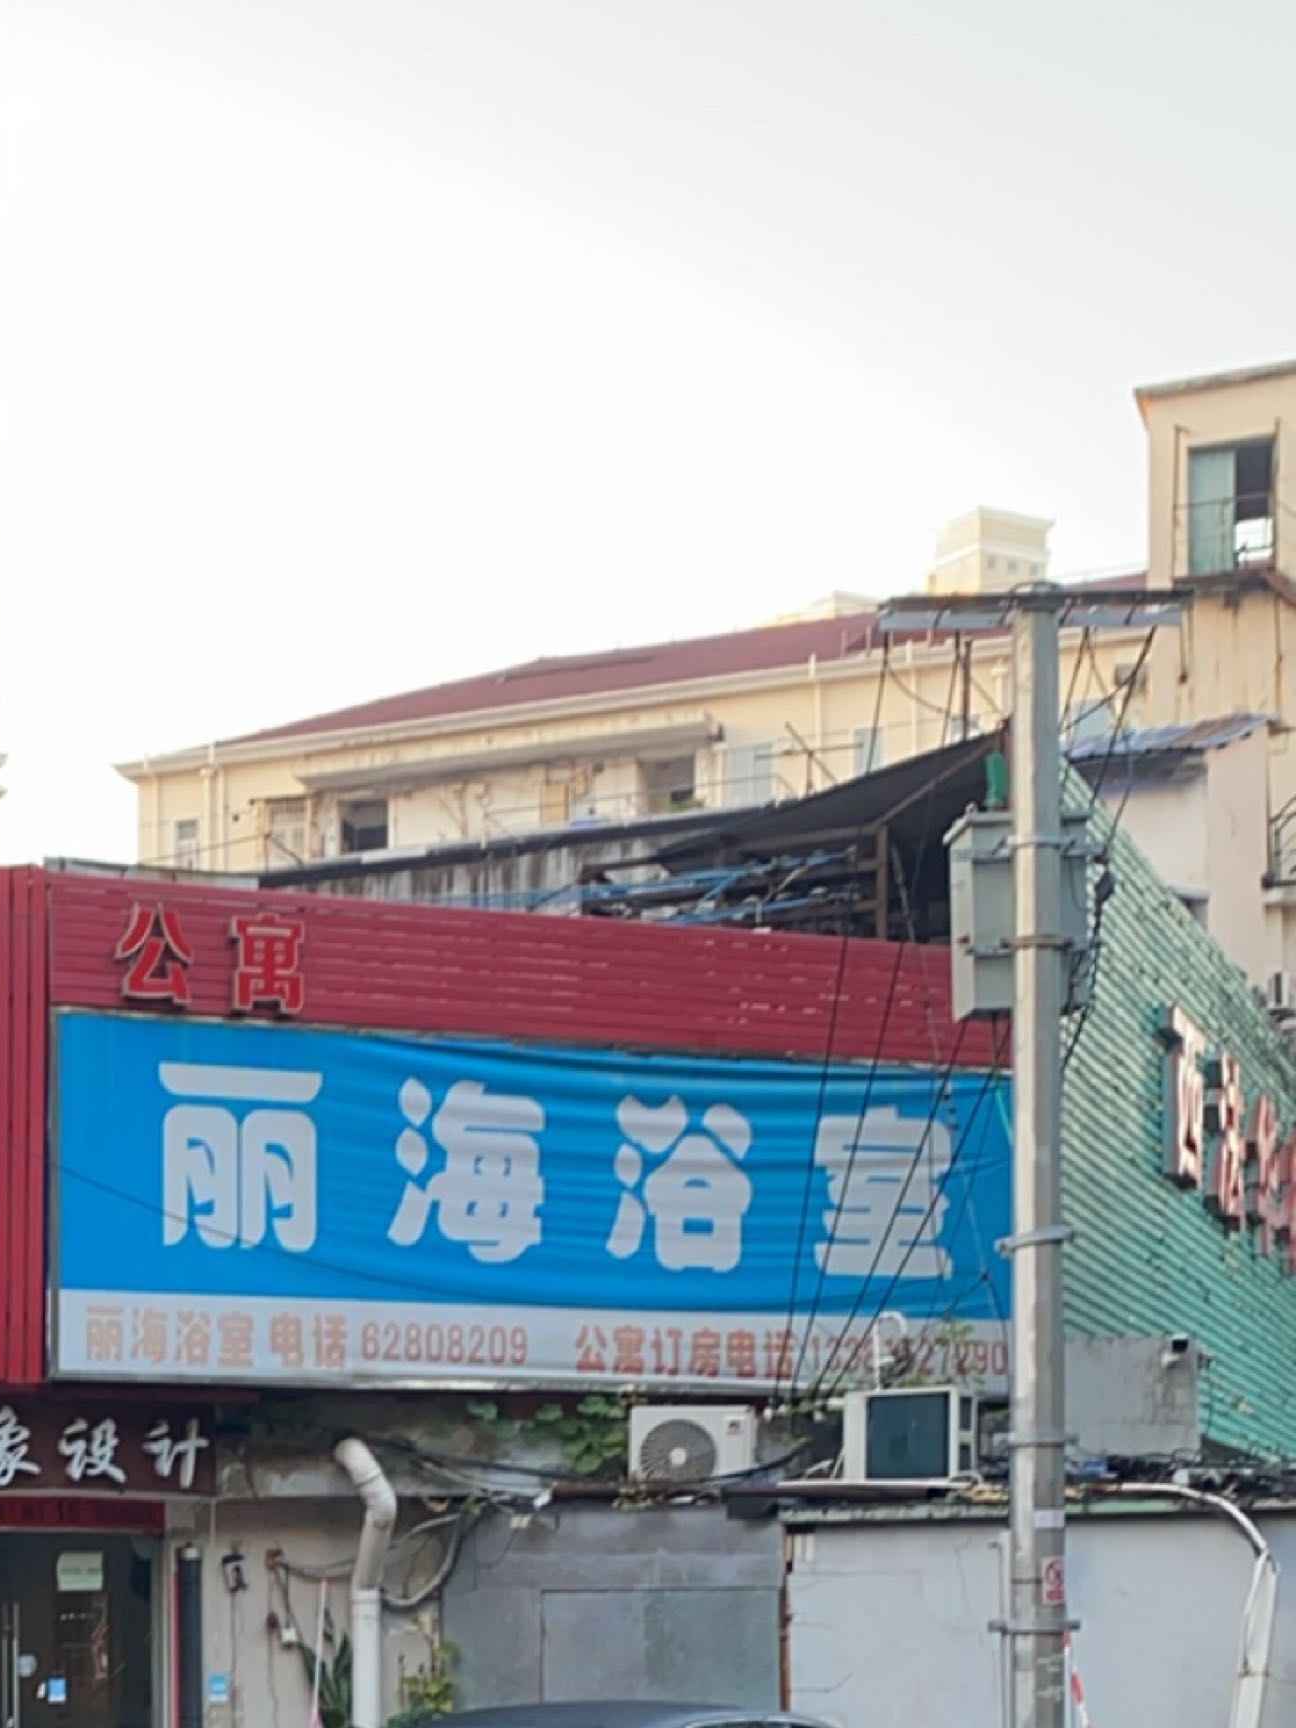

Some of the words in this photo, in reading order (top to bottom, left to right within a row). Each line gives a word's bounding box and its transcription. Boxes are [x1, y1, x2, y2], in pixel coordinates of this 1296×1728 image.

[114, 901, 304, 1014] 公寓
[158, 1062, 954, 1280] 丽海浴室
[360, 1319, 530, 1367] 62808209
[575, 1323, 795, 1380] 公寓订房电话
